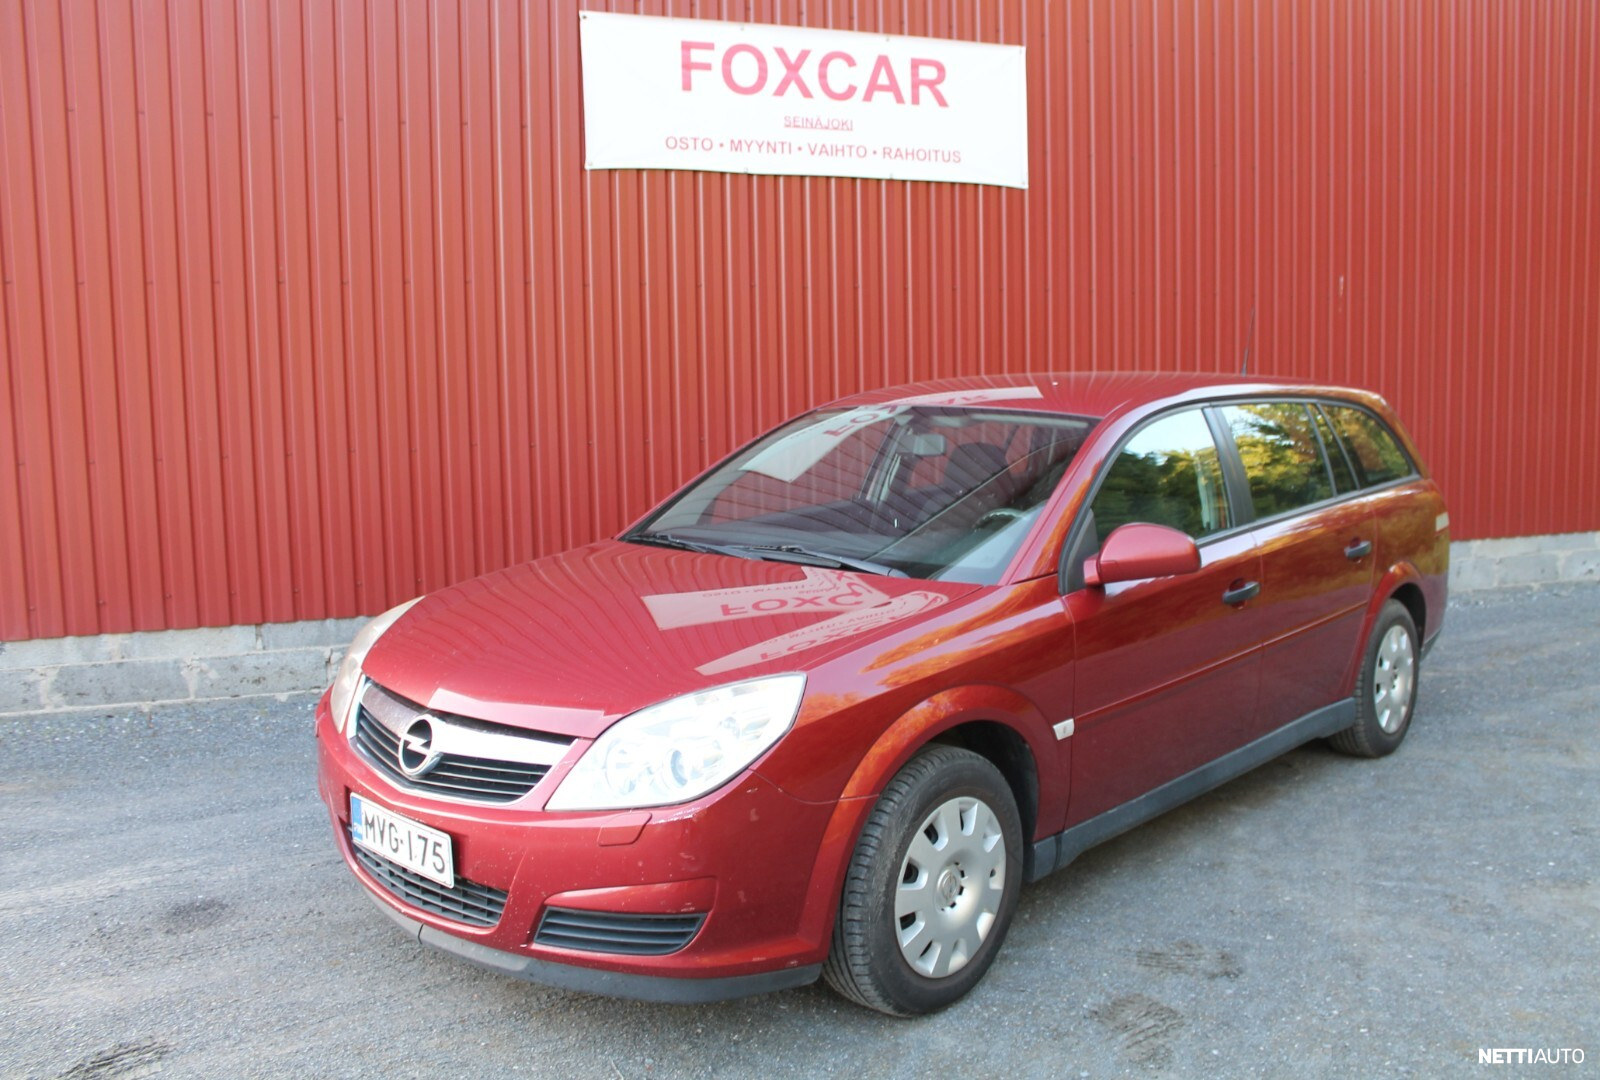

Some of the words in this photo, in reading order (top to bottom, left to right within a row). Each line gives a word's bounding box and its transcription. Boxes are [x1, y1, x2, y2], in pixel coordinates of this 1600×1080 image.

[680, 40, 950, 108] FOXCAR
[665, 136, 714, 152] OSTO
[729, 139, 793, 156] MYYNTI
[807, 142, 868, 159] VAIHTO
[882, 146, 962, 164] RAHOITUS
[364, 812, 445, 874] MVG-175
